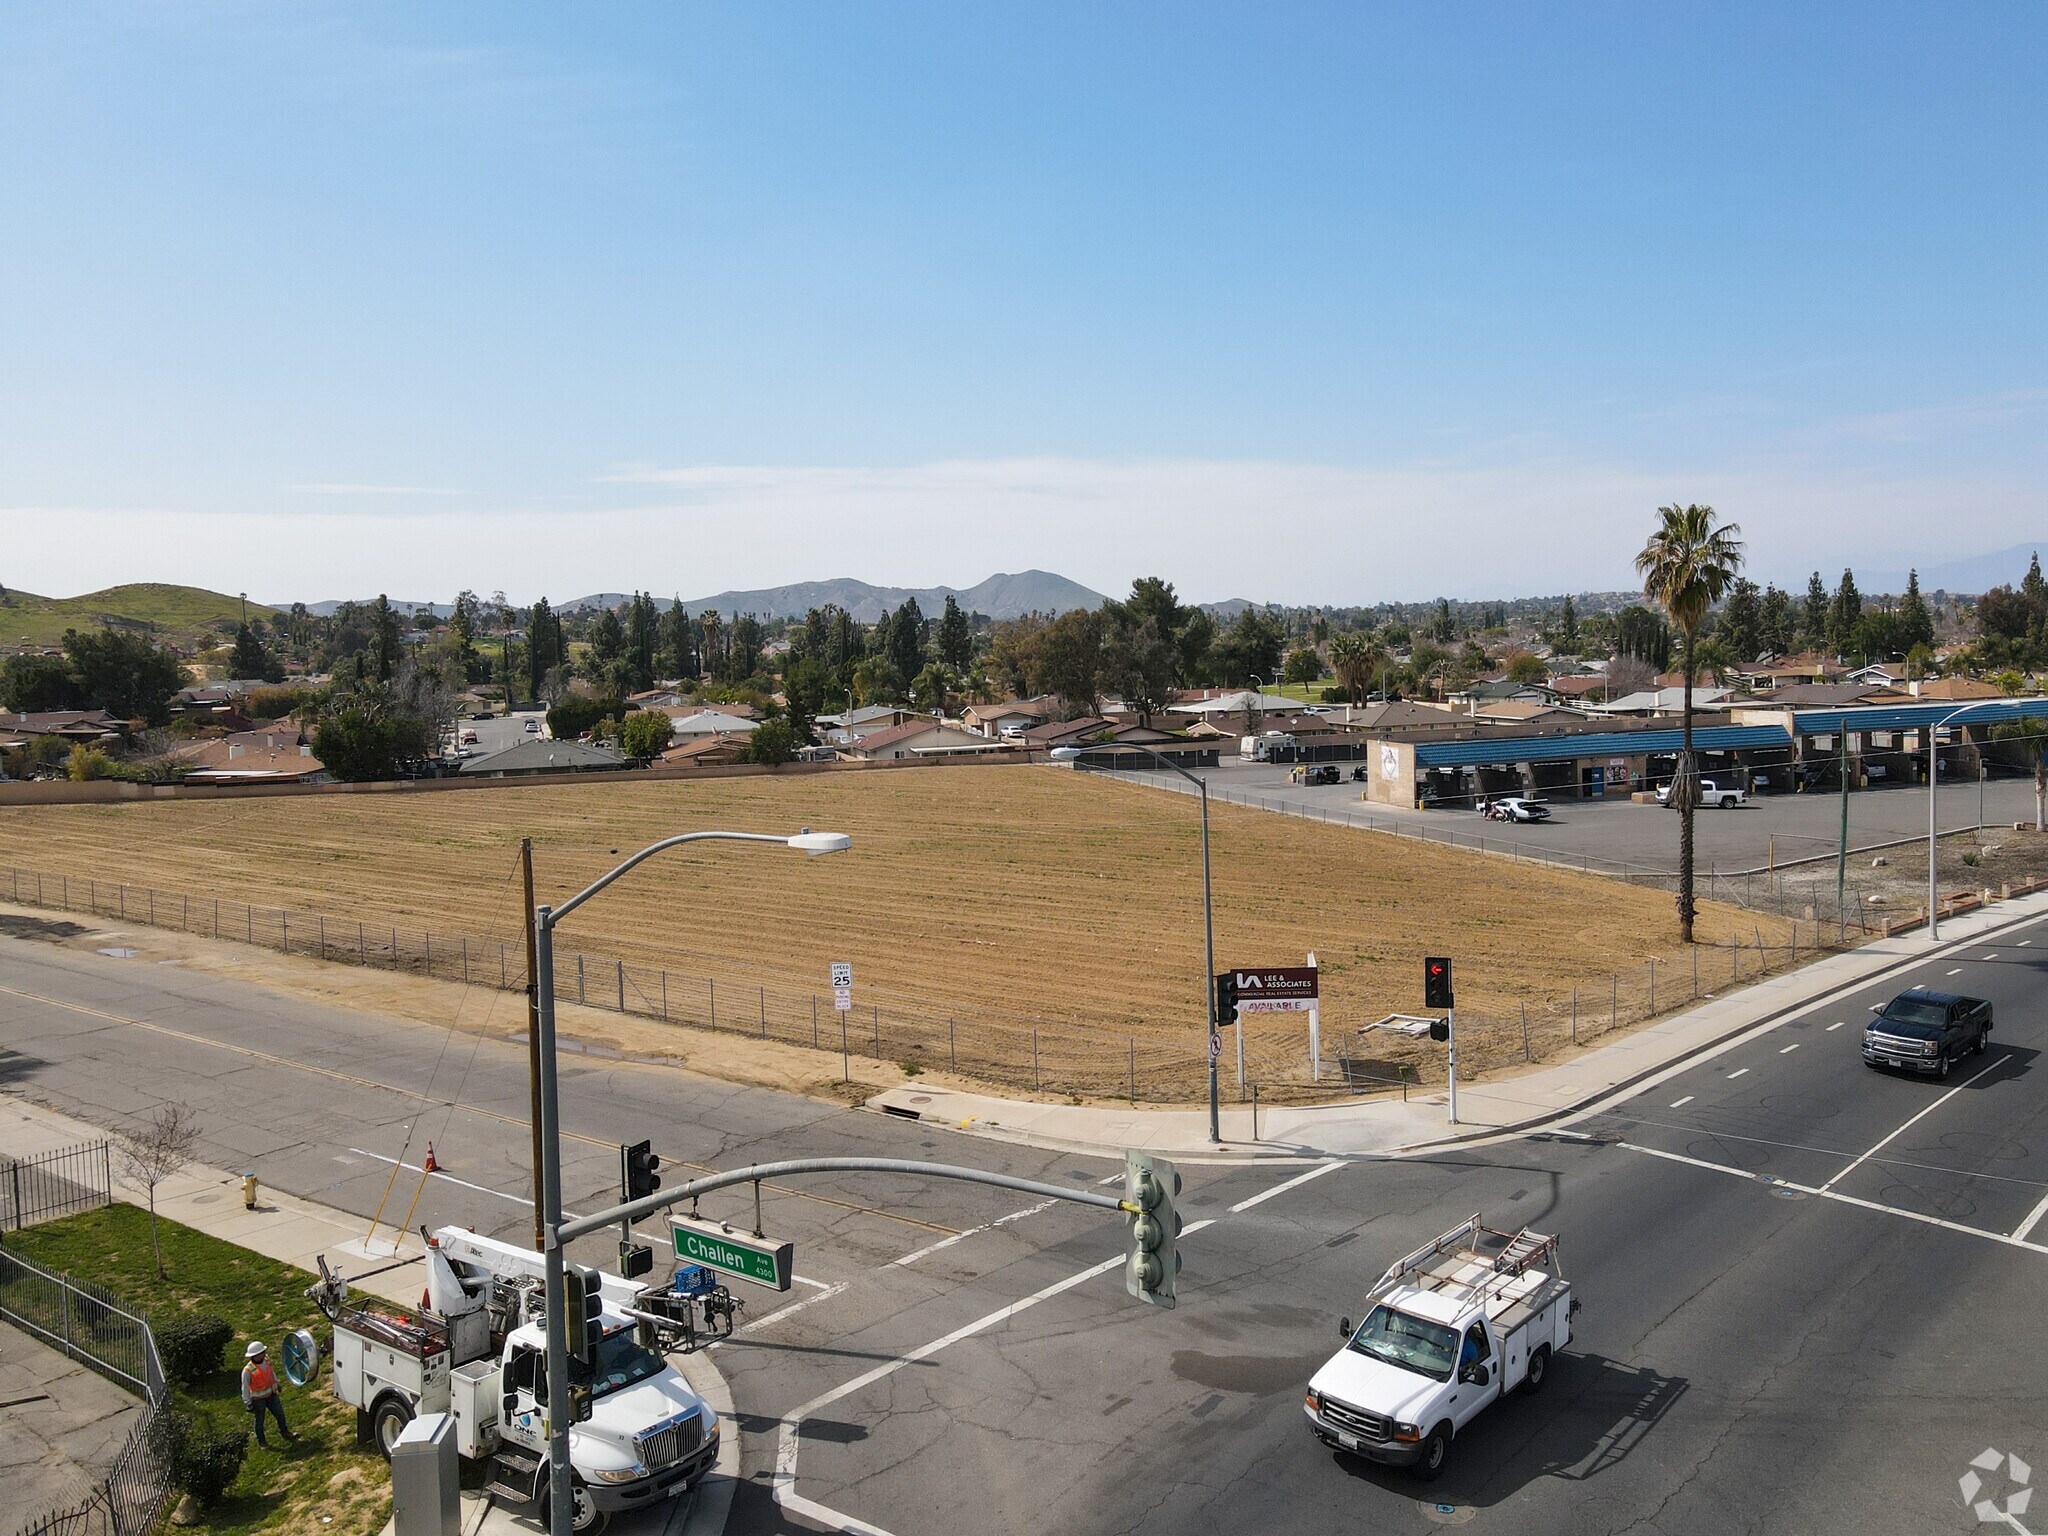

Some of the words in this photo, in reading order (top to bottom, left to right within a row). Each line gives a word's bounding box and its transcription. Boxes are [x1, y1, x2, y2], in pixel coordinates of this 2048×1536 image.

[834, 976, 850, 986] 25
[1248, 1002, 1301, 1010] AVAILABLE
[687, 1236, 745, 1270] Challen
[756, 1256, 768, 1266] Ave
[756, 1267, 772, 1278] 4300
